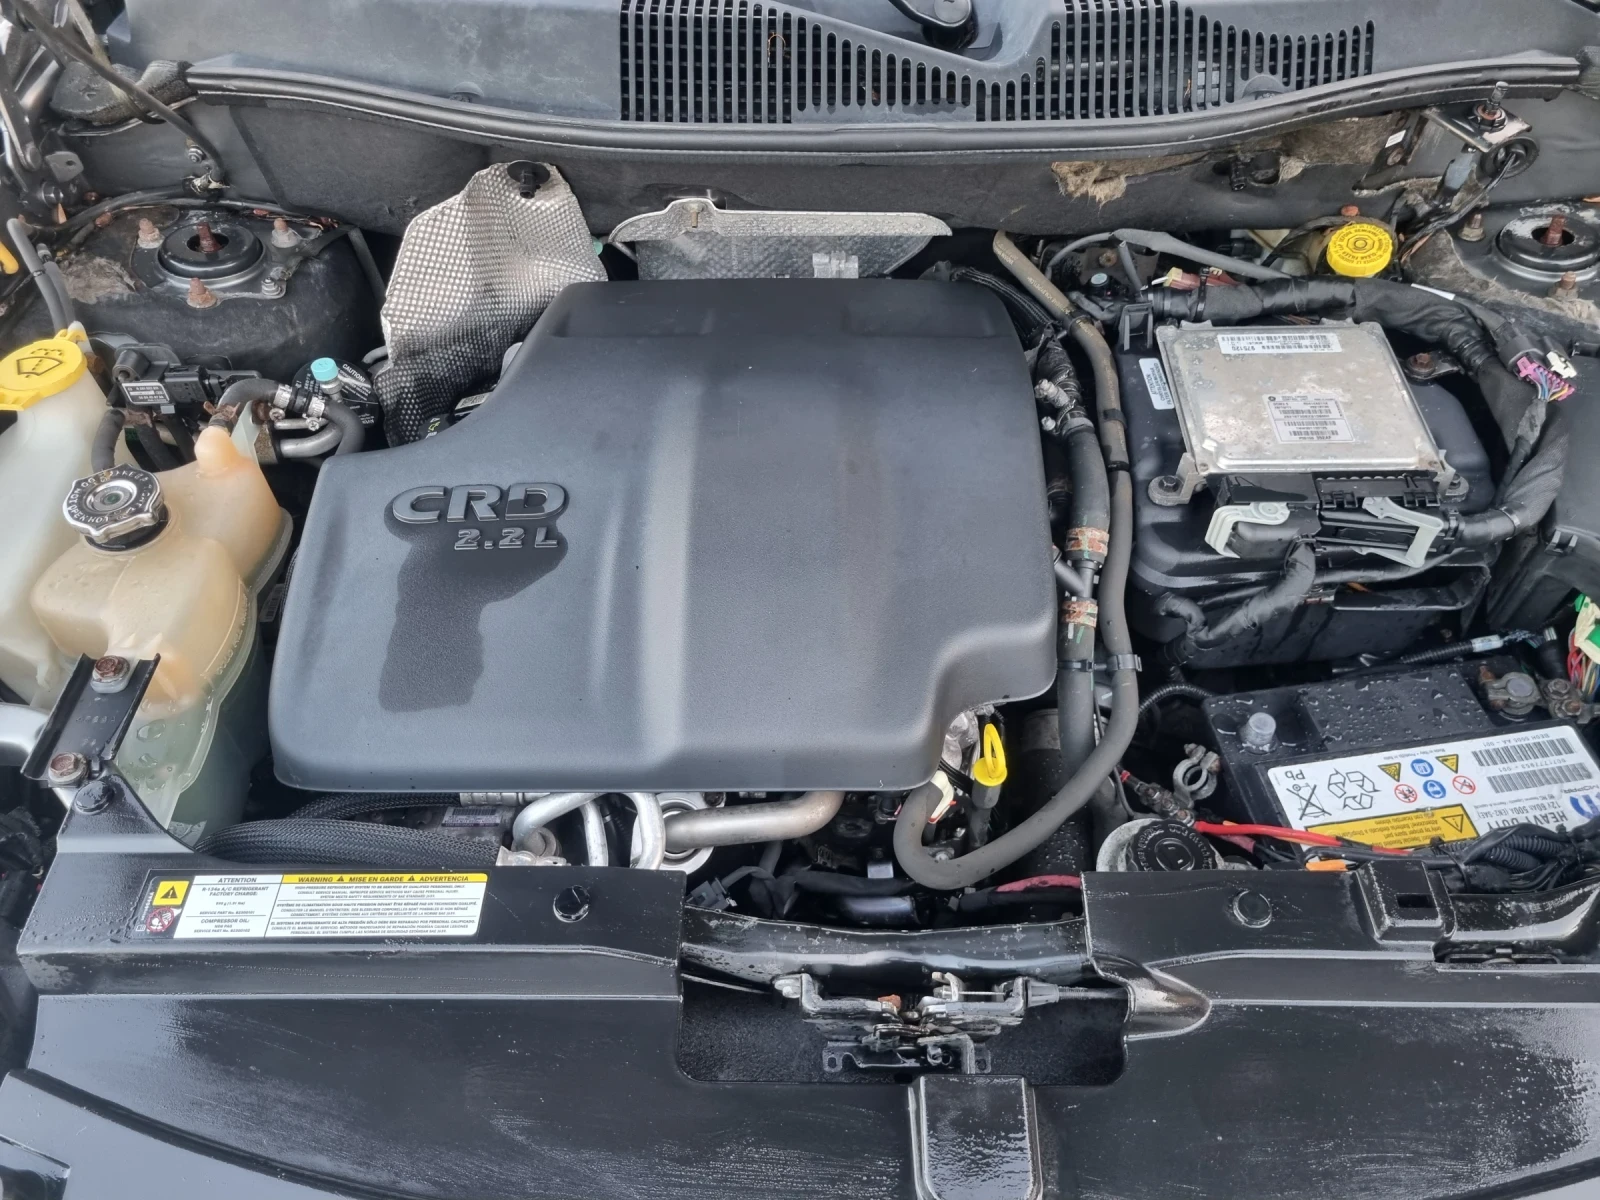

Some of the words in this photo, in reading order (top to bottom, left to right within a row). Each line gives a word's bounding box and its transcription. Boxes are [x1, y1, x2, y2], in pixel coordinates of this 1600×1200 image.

[342, 364, 366, 382] CAUTION!
[392, 482, 568, 524] CRD
[1285, 769, 1305, 780] Pb
